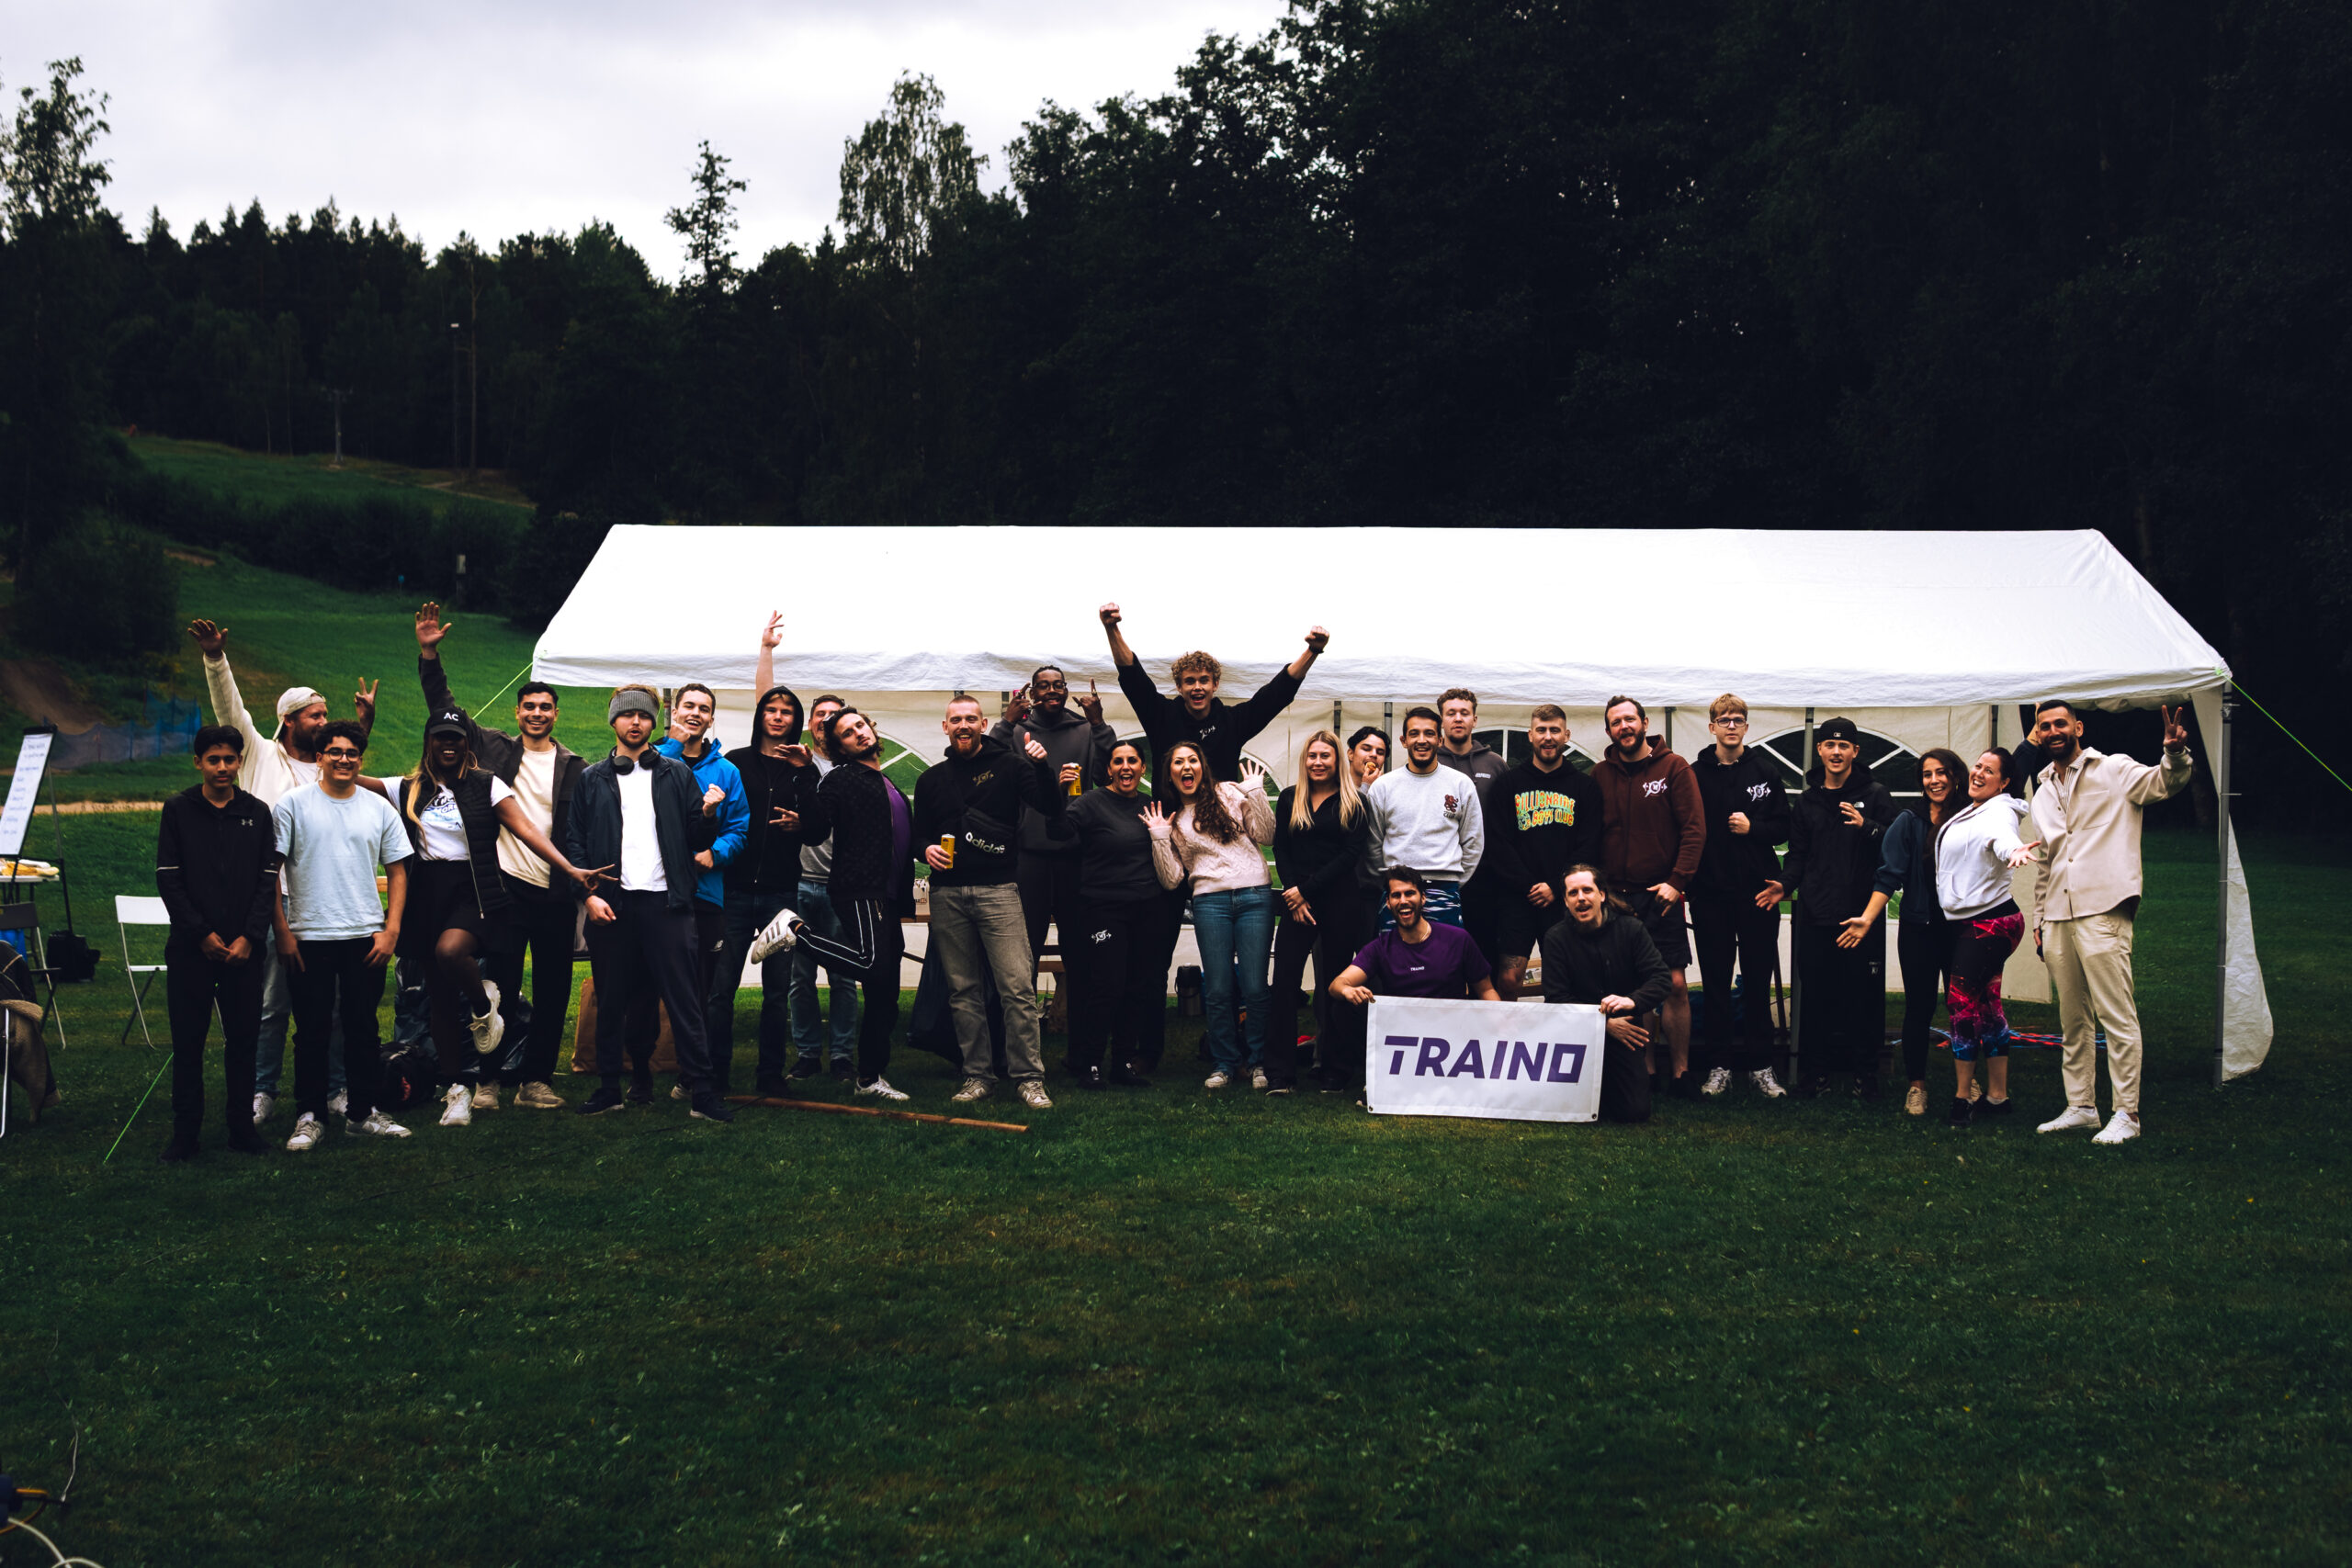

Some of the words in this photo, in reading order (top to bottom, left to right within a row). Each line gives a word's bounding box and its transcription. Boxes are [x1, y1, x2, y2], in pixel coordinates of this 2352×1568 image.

[443, 712, 459, 721] AC
[1555, 808, 1574, 826] CLUB
[966, 831, 1005, 854] adidas
[1384, 1035, 1588, 1084] TRAINO
